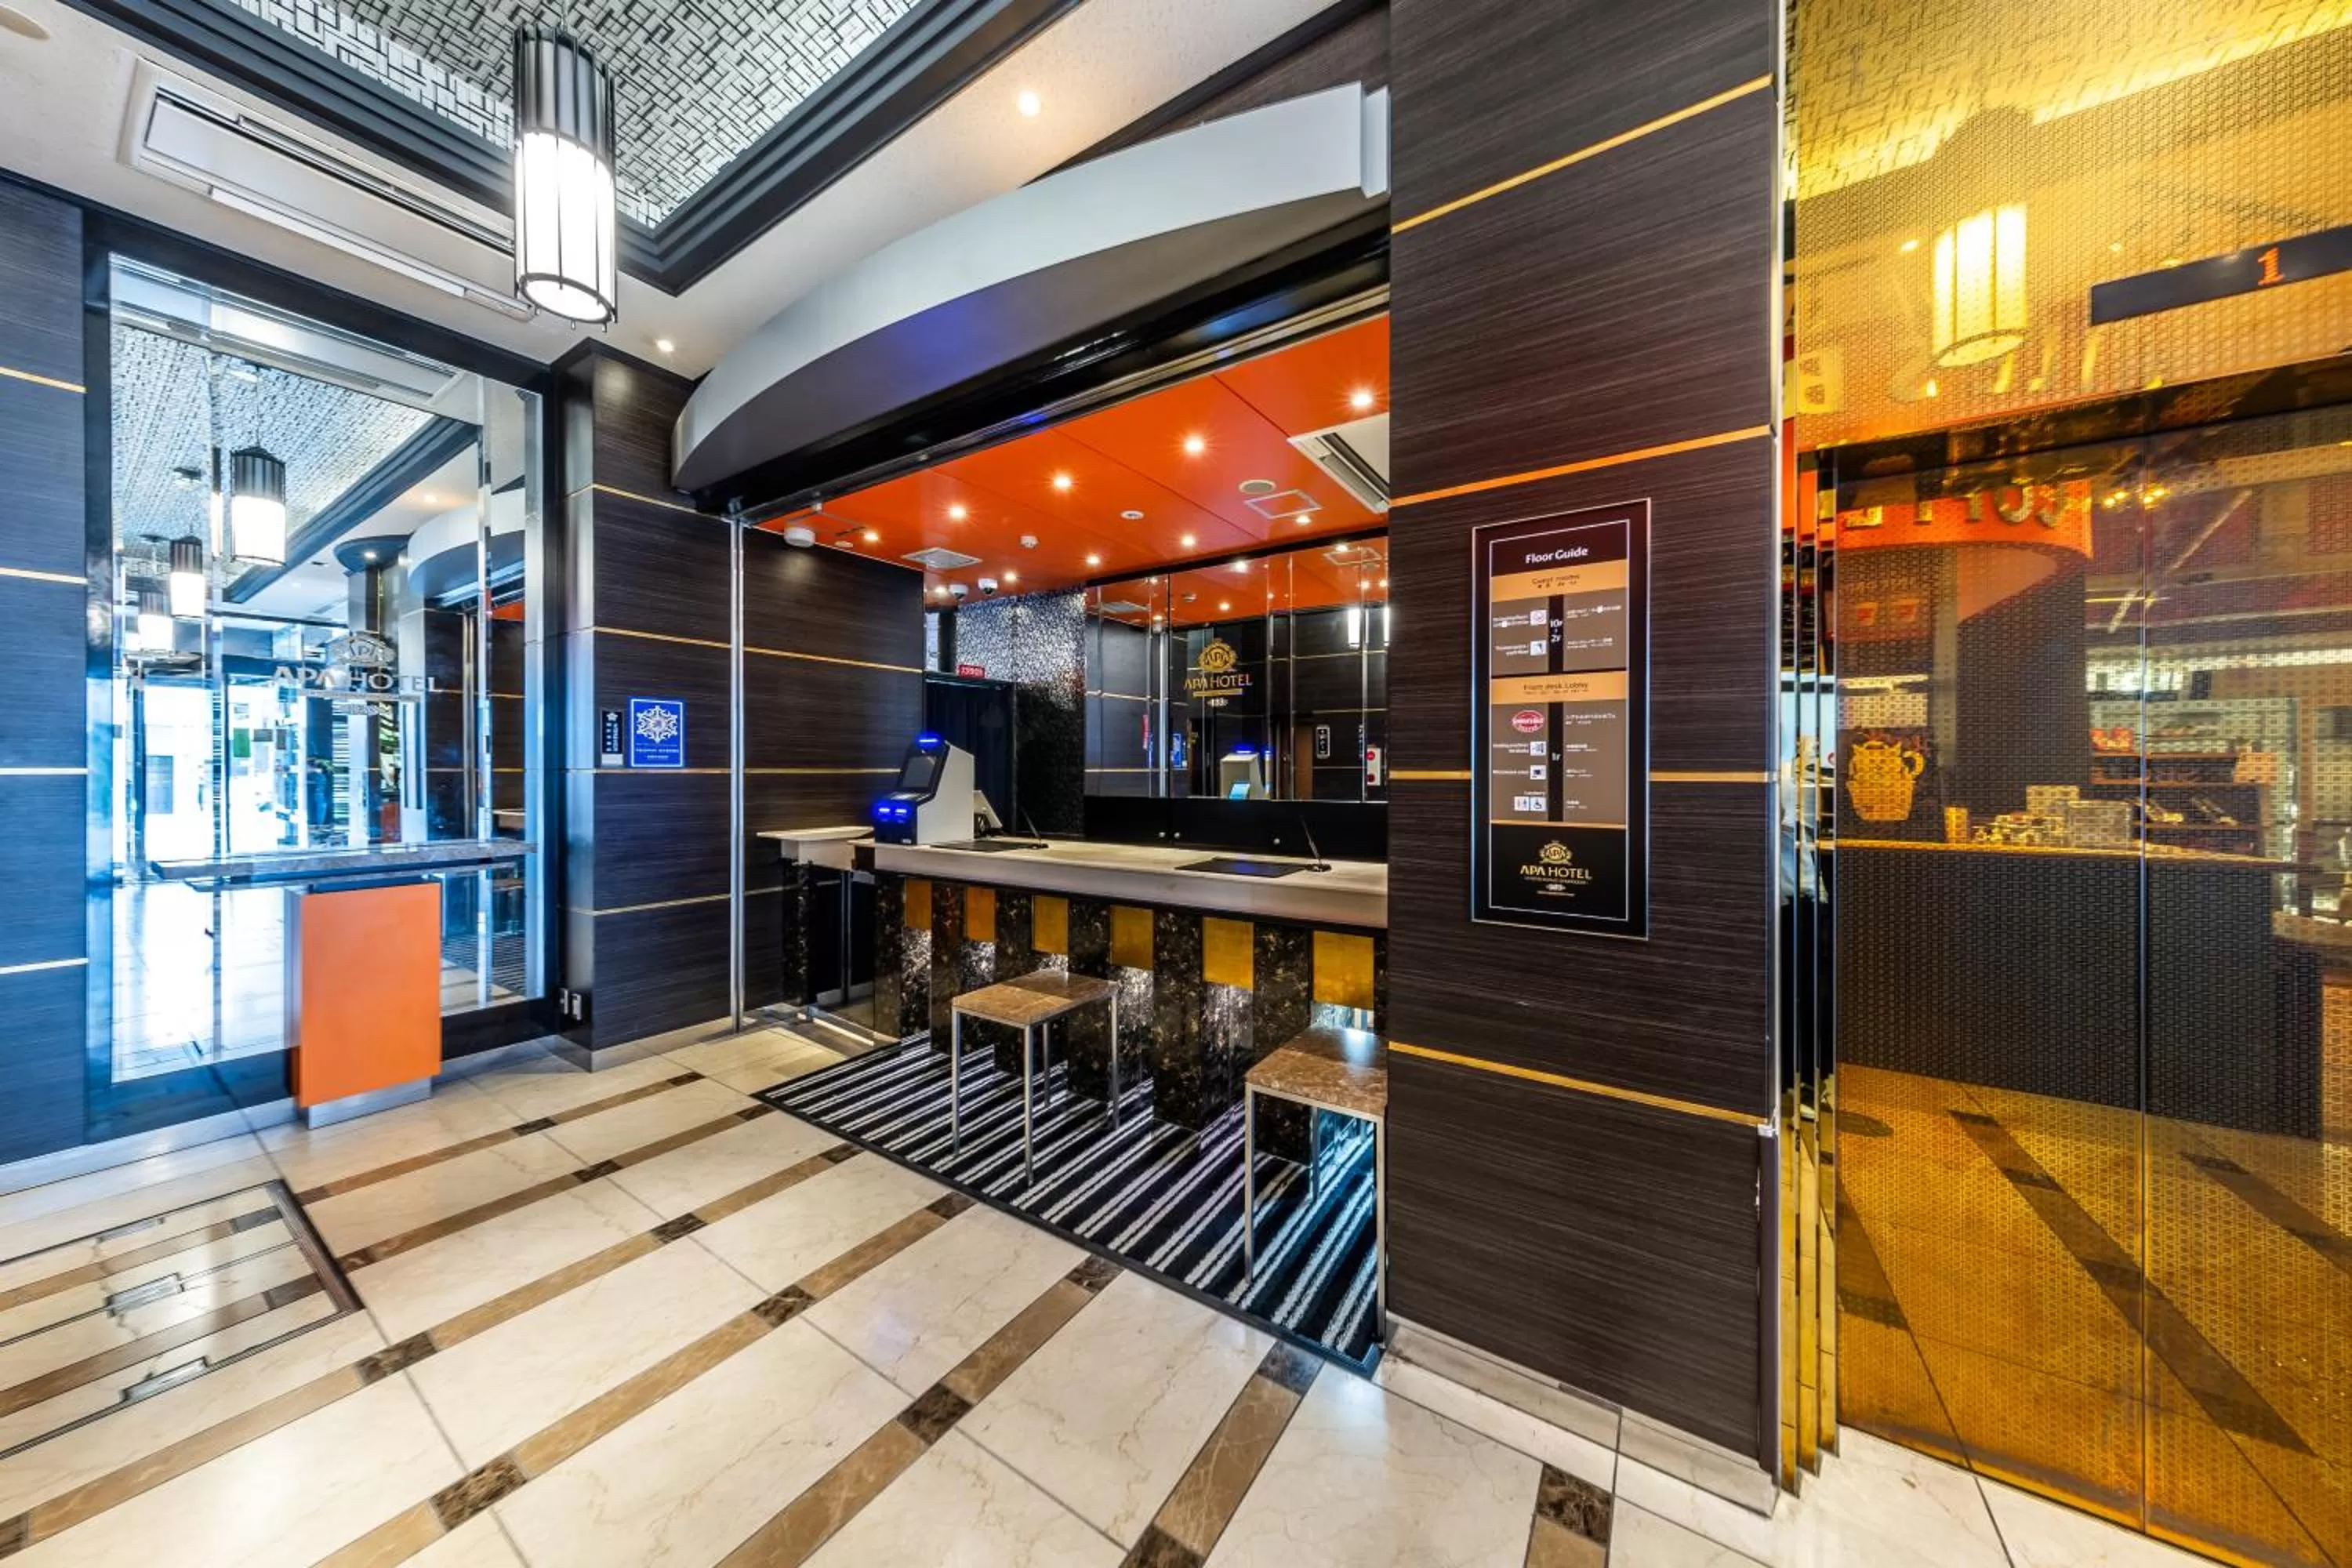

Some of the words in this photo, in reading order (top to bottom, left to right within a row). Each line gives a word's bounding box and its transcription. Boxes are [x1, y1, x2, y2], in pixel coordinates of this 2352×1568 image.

[2257, 247, 2284, 285] 1
[1525, 552, 1553, 564] Floor
[1555, 546, 1588, 560] Guide
[274, 666, 336, 689] APA
[349, 671, 445, 693] HOTEL
[1184, 677, 1208, 690] APA
[1210, 673, 1254, 688] HOTEL
[1519, 865, 1546, 876] APA
[1548, 866, 1593, 880] HOTEL
